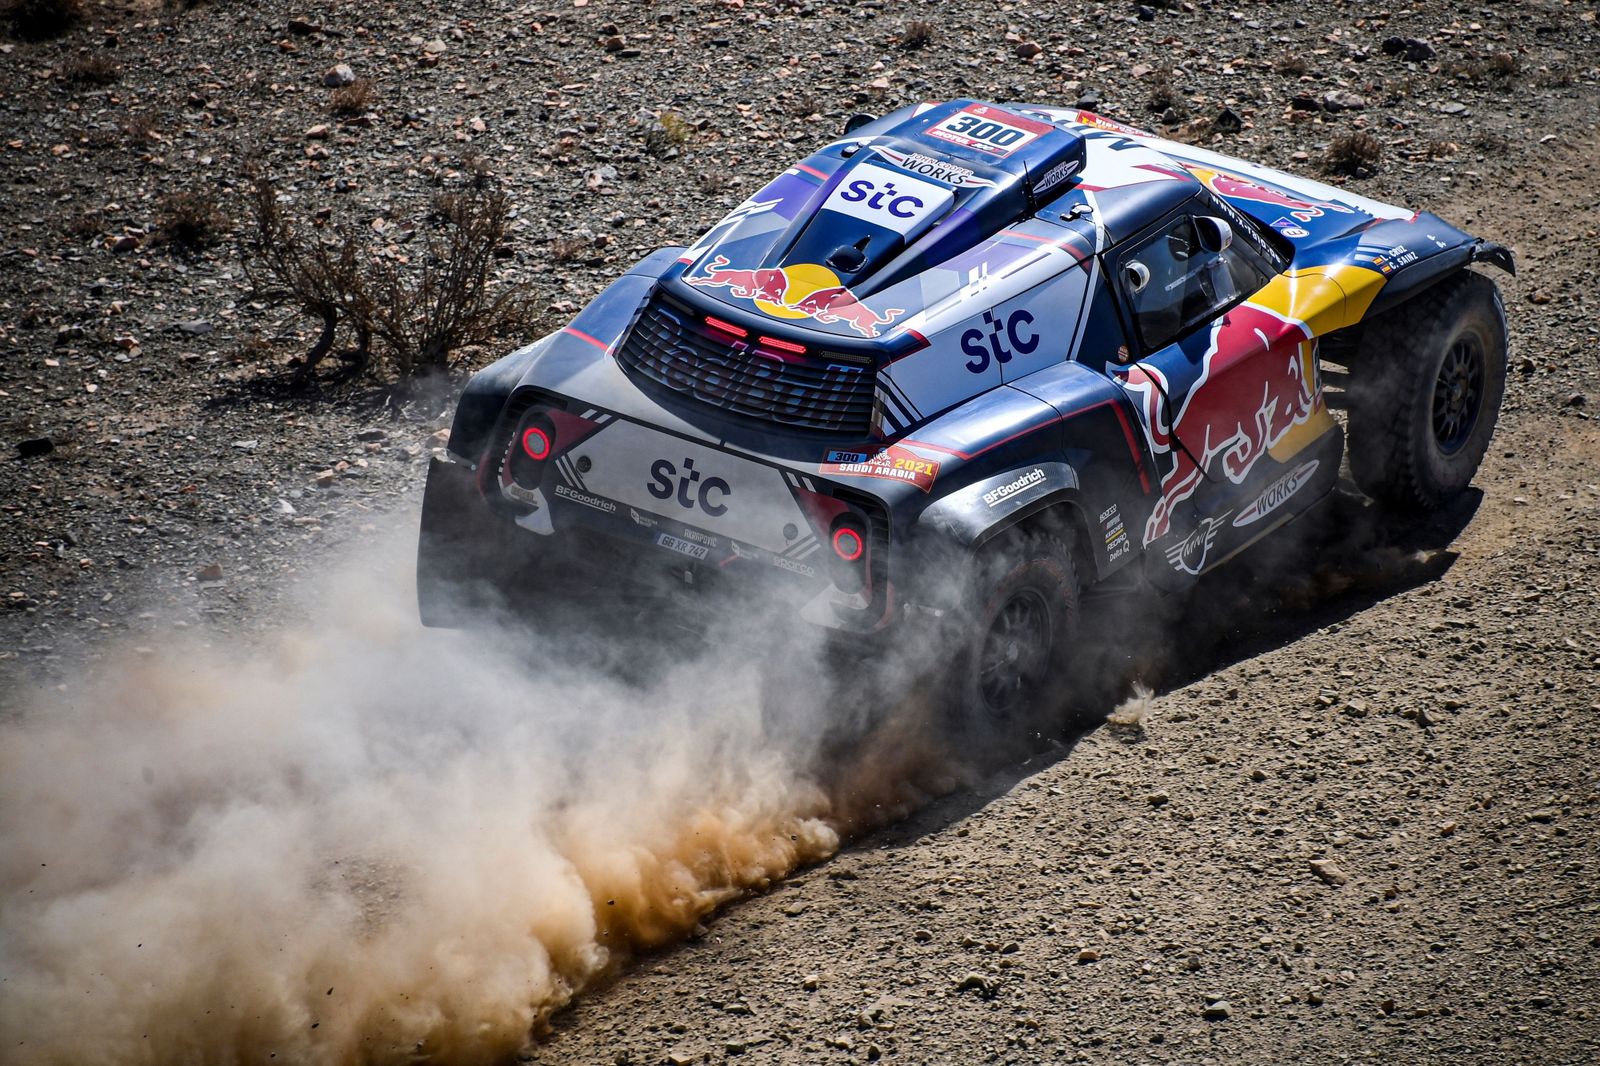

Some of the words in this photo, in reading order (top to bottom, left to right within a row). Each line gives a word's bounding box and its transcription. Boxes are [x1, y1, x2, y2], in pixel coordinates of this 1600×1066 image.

[932, 131, 968, 145] MOTUL
[946, 116, 1025, 147] 300
[902, 158, 969, 184] WORKS
[910, 153, 937, 165] JOHN
[937, 161, 974, 177] COOPER
[1044, 167, 1068, 187] WORKS
[841, 180, 924, 218] stc
[1388, 245, 1407, 257] CRUZ
[1397, 251, 1418, 266] SAINZ
[960, 309, 1040, 374] stc
[835, 452, 859, 463] 300
[895, 458, 934, 476] 2021
[839, 463, 873, 473] SAUDI
[874, 466, 916, 481] ARABIA
[554, 484, 617, 512] BFGoodrich
[647, 457, 731, 517] stc
[982, 468, 1045, 505] BFGoodrich
[1256, 472, 1299, 515] WORKS
[675, 539, 688, 552] XR
[688, 545, 706, 558] 747
